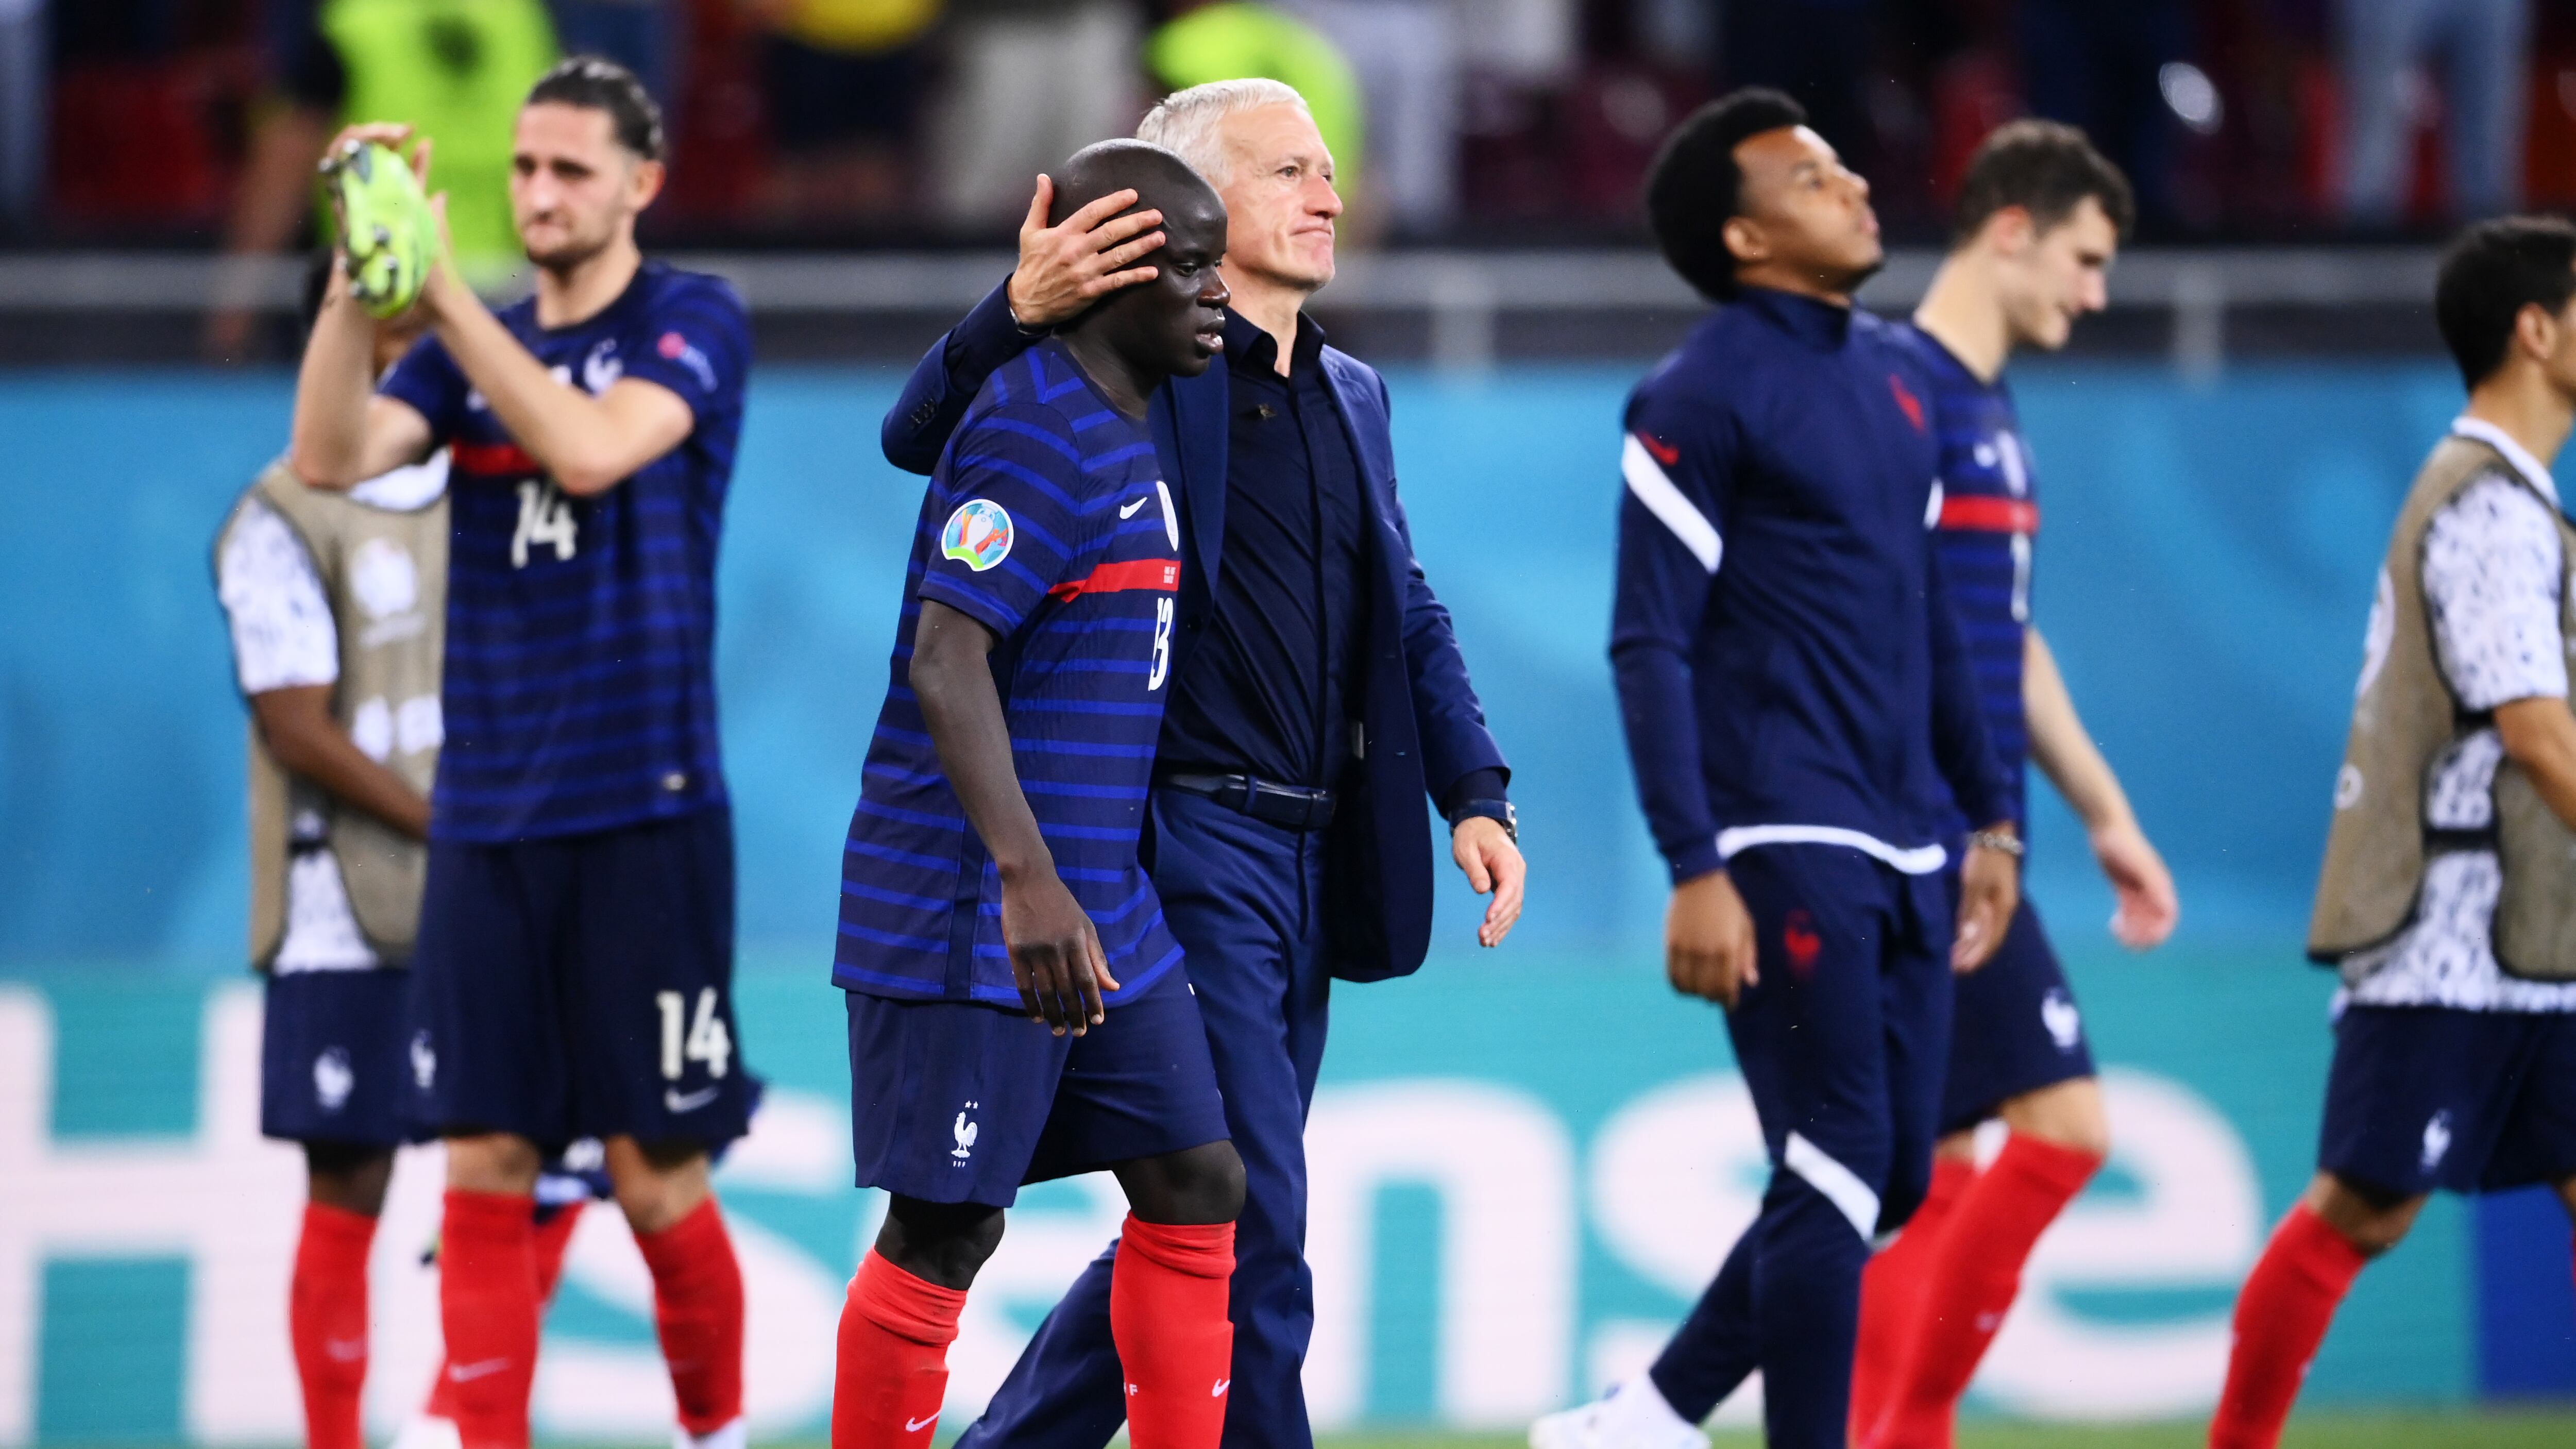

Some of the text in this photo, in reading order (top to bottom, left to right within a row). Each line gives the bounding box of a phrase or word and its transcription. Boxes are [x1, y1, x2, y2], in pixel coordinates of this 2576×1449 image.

[510, 478, 579, 570] 14
[1148, 597, 1174, 691] 13
[656, 986, 731, 1080] 14
